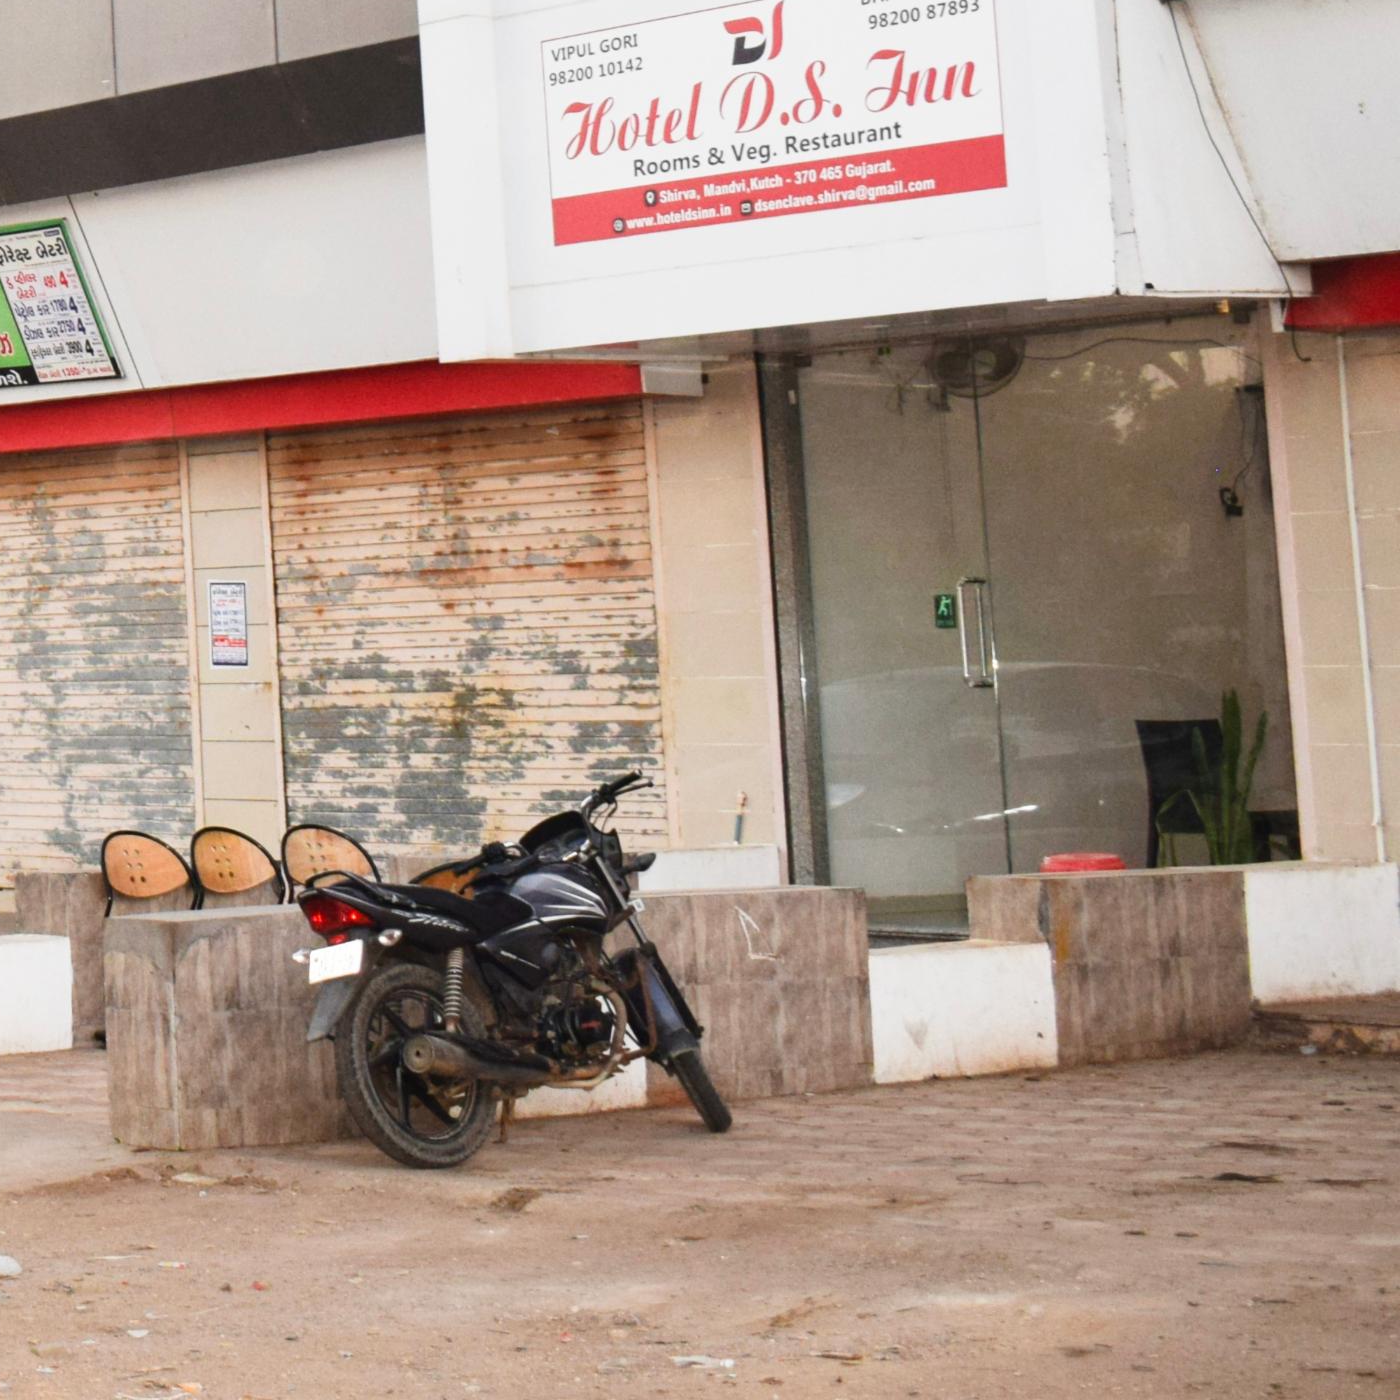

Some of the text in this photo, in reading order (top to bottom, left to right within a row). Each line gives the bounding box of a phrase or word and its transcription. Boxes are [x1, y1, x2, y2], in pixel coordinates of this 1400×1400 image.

[868, 7, 920, 30] 98200
[551, 33, 638, 62] VIPUL GORI
[549, 56, 643, 86] 98200 10142
[561, 49, 983, 160] Hotel D.S. Inn
[633, 121, 903, 177] Rooms & Veg. Restaurant
[659, 186, 701, 204] Shirva,
[794, 168, 817, 185] 370
[819, 165, 843, 181] 465
[845, 159, 896, 179] Gujarat.
[754, 178, 936, 213] dsenclave.shirva@gmail.com
[626, 204, 732, 230] www.hoteldsinn.in
[59, 271, 69, 288] 4
[69, 296, 79, 314] 4
[77, 317, 87, 335] 4
[85, 339, 95, 356] 4
